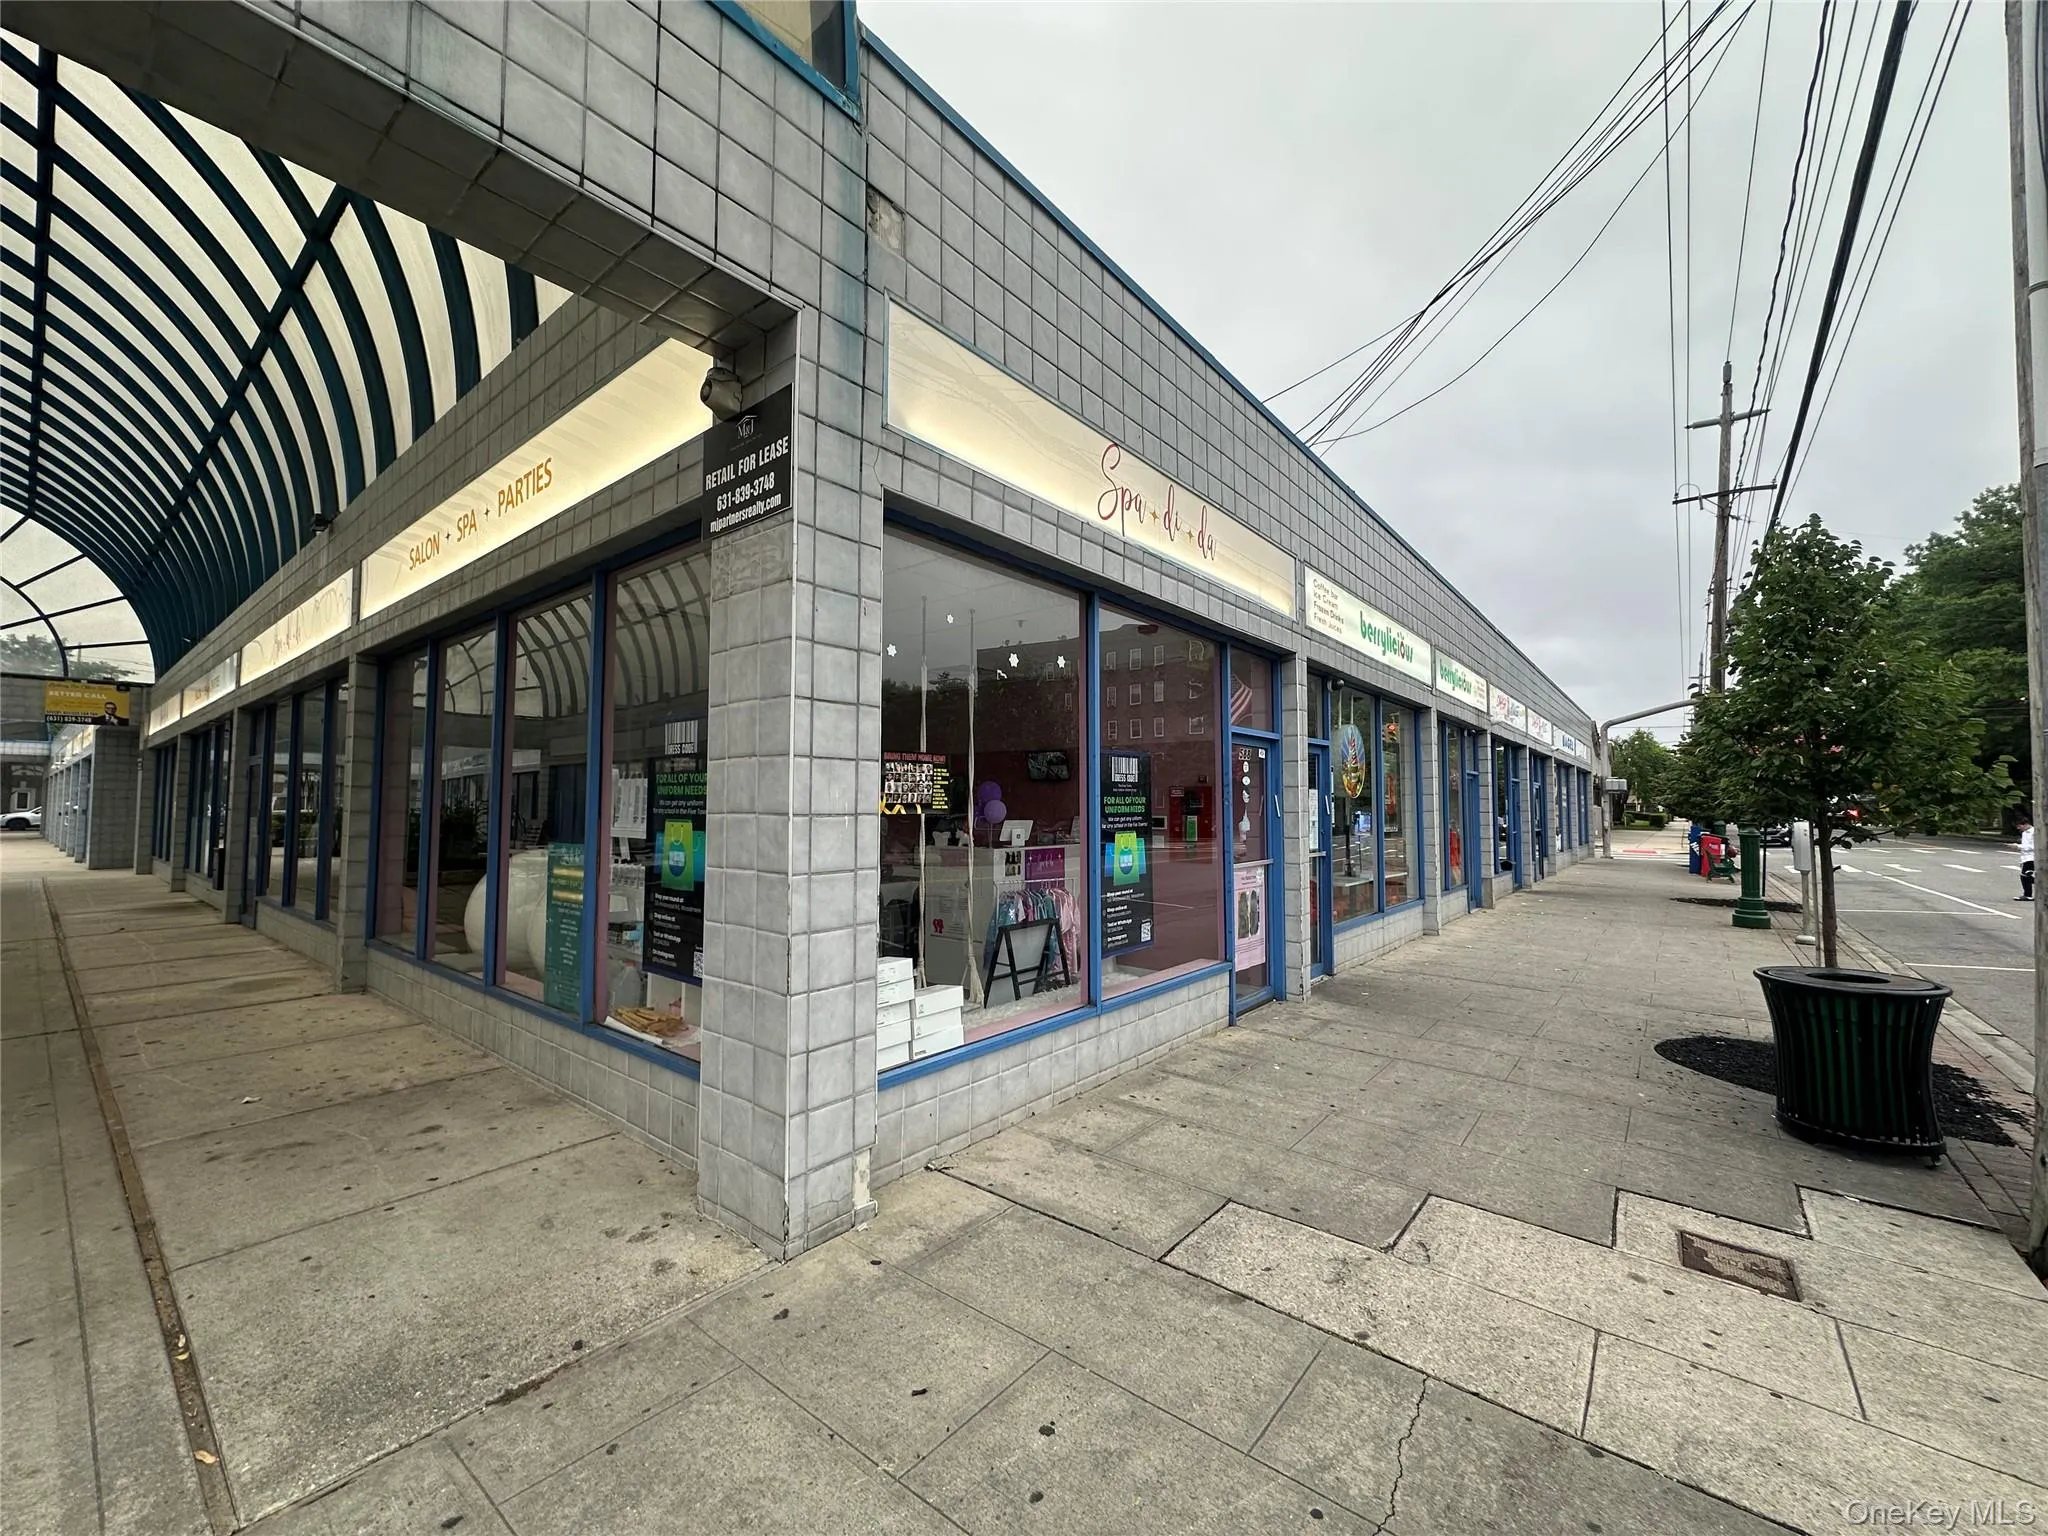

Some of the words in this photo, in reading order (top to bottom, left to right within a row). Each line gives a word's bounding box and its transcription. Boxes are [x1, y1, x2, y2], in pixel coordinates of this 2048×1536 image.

[706, 464, 736, 490] RETAIL
[738, 453, 756, 476] FOR
[759, 436, 789, 466] LEASE
[409, 532, 440, 571] SALON
[456, 509, 478, 542] SPA
[498, 457, 552, 518] PARTIES
[710, 493, 782, 533] mjpartnersrealty.com
[716, 472, 775, 512] 631-839-3748
[1098, 443, 1146, 537] Spa
[1164, 484, 1182, 541] di
[1198, 505, 1216, 560] da
[1360, 610, 1413, 663] berrylicious
[678, 773, 686, 783] OF
[1104, 796, 1115, 804] FOR
[1116, 796, 1125, 804] ALL
[1125, 796, 1131, 804] OF
